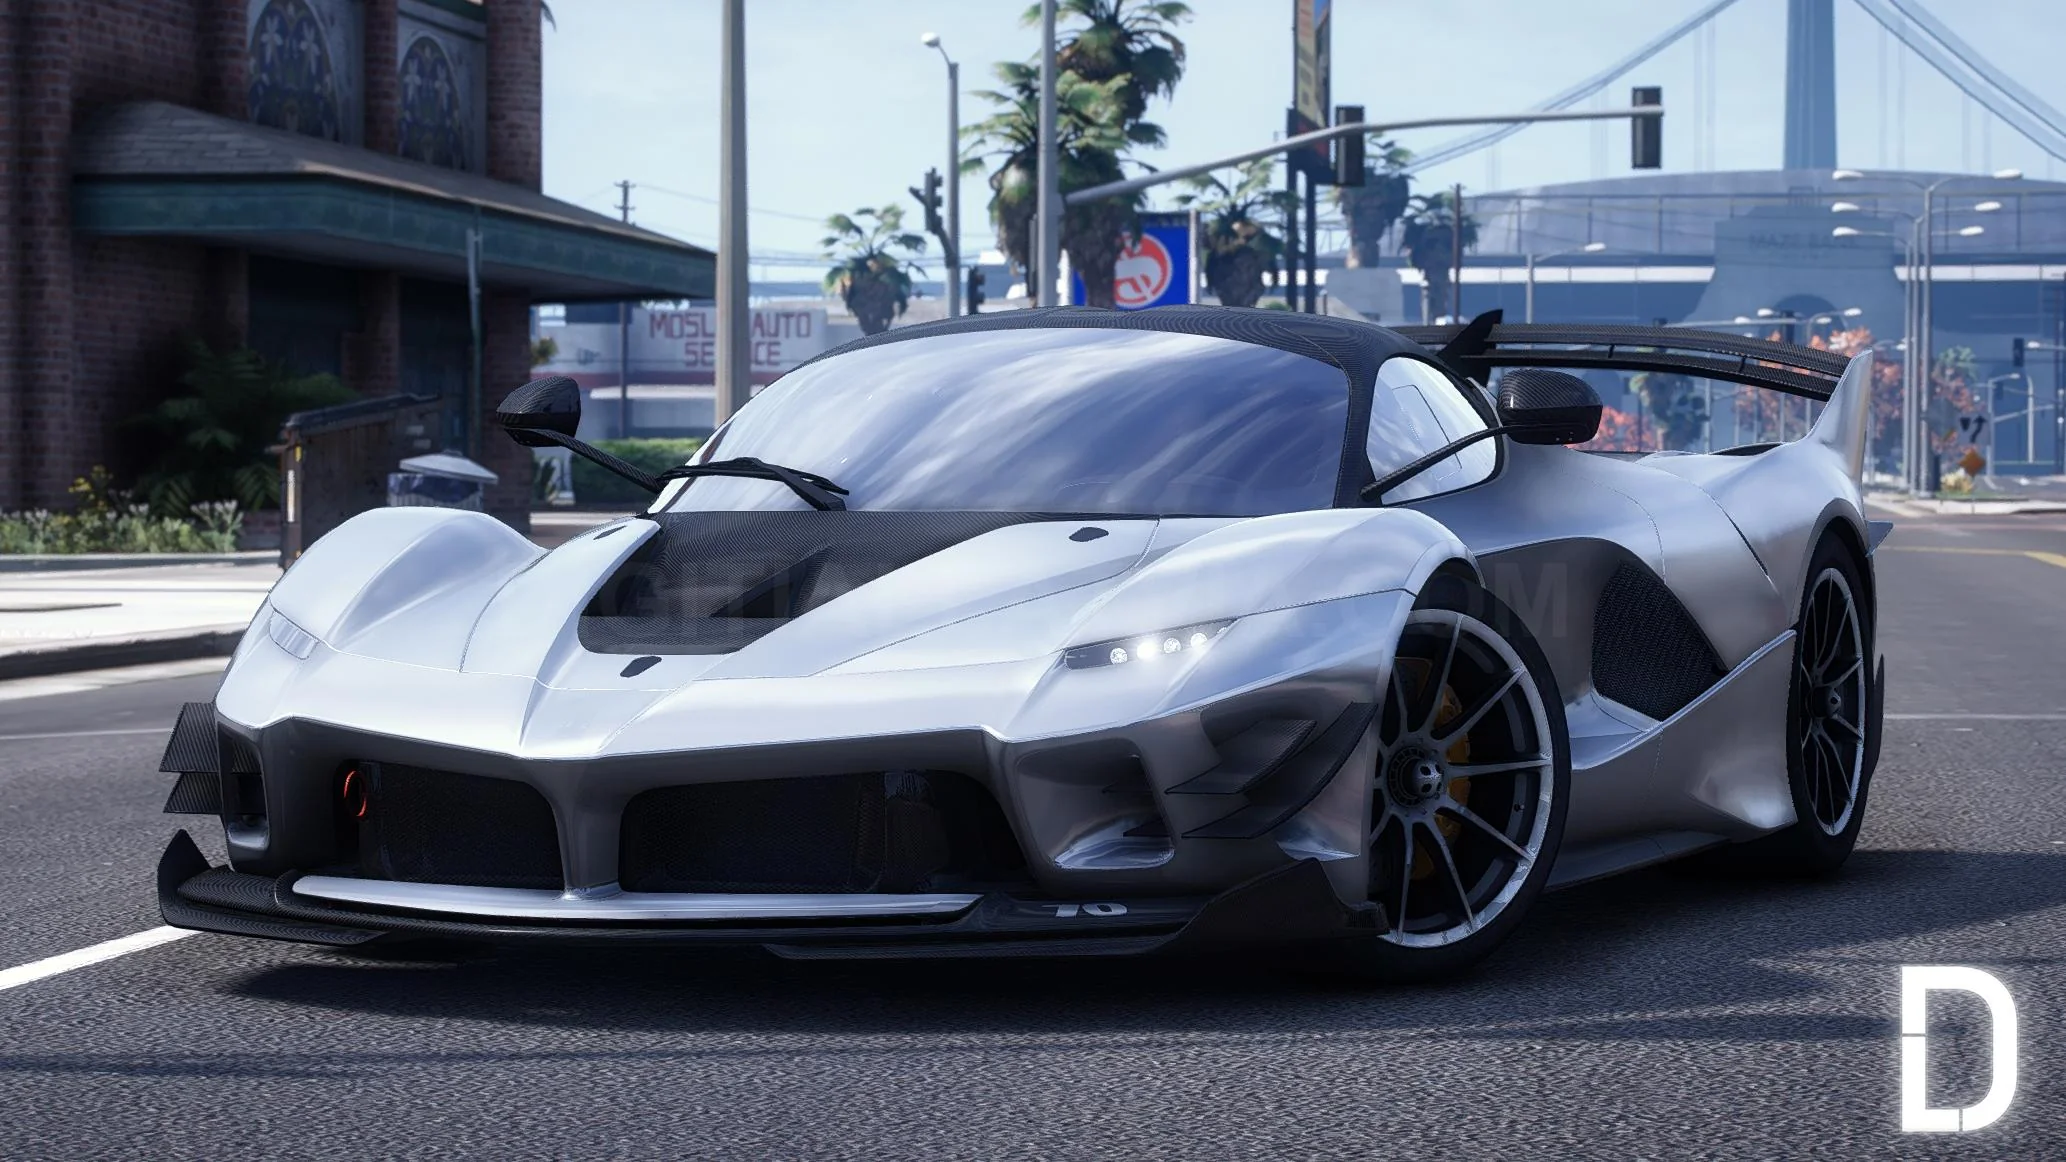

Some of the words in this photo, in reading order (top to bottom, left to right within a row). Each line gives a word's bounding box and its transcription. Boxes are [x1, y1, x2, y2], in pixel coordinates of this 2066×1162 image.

[650, 312, 716, 339] MOSL
[751, 311, 812, 339] AUTO
[685, 341, 781, 367] SECE
[1041, 903, 1128, 918] 10
